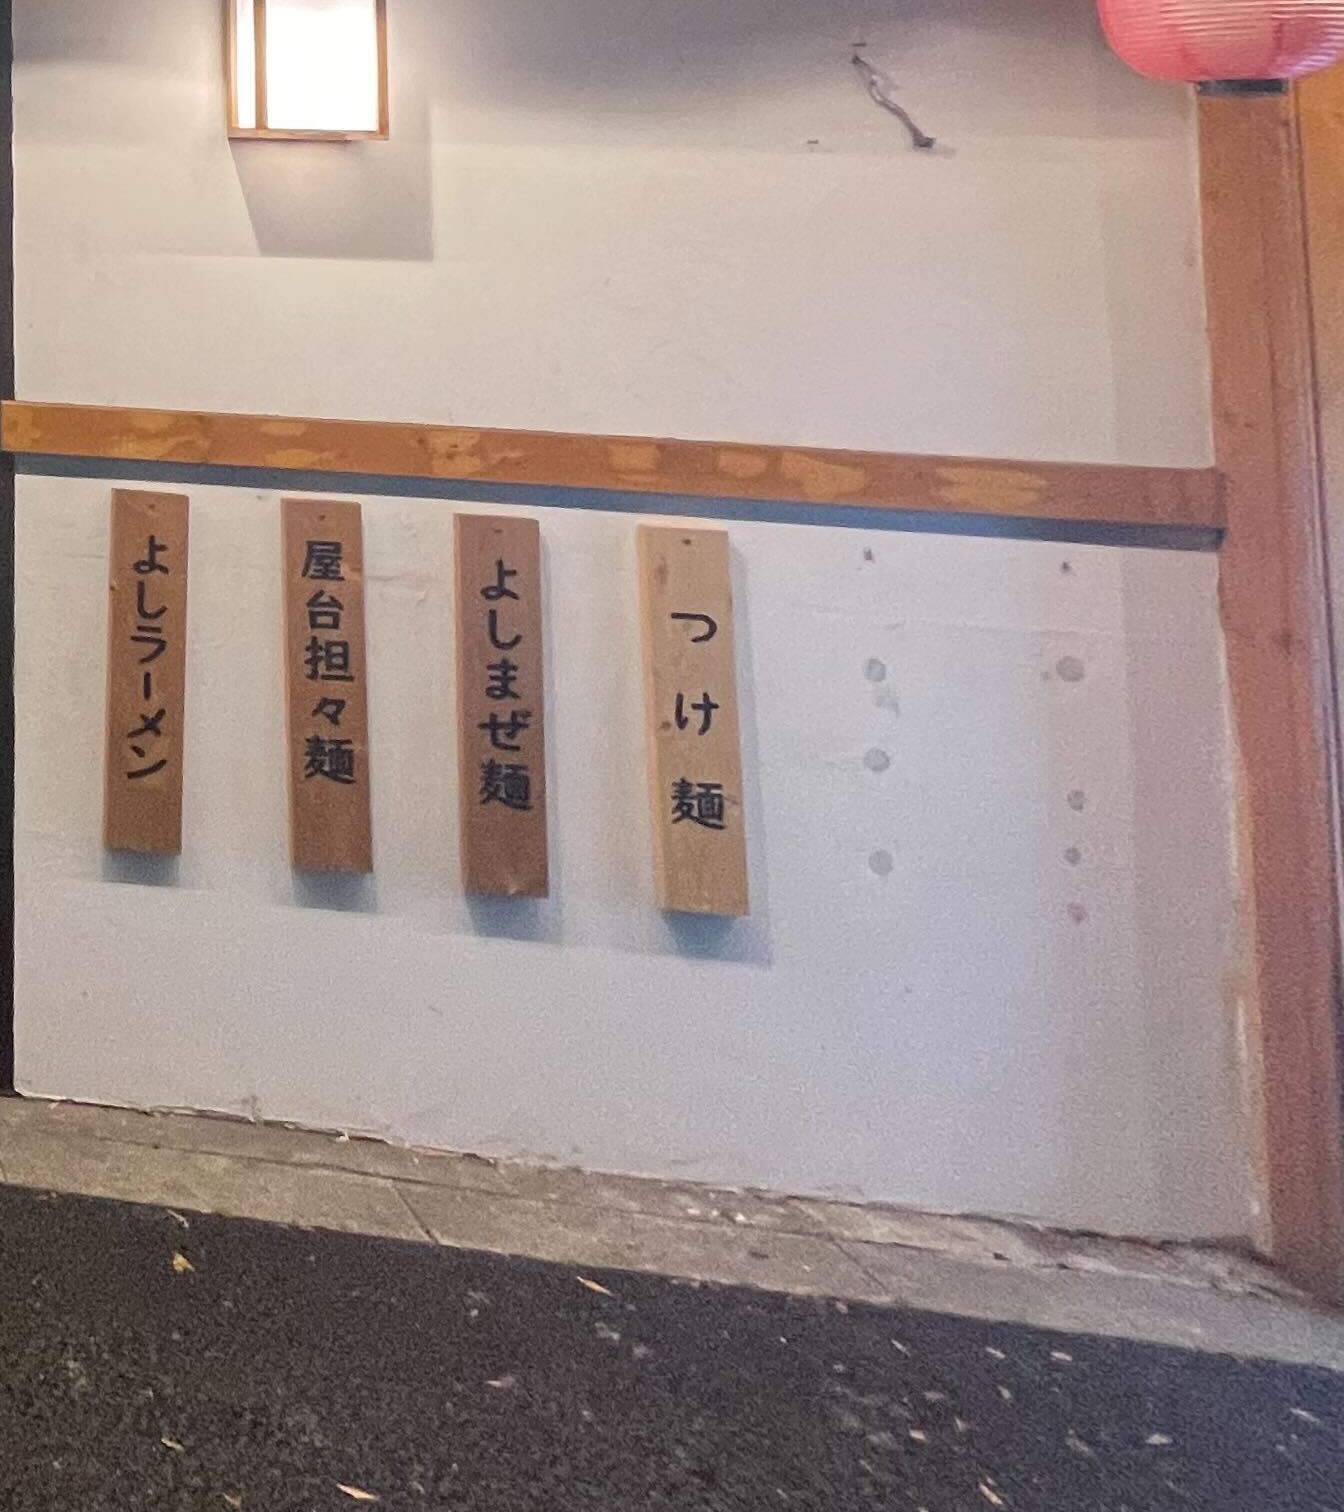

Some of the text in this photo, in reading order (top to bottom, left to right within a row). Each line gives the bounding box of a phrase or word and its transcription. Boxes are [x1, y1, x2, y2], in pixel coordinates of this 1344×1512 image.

[126, 534, 171, 780] よしラーメン
[300, 539, 357, 785] 屋台担々麺
[476, 558, 534, 812] よしまぜ麺
[670, 611, 726, 831] つけ麺
